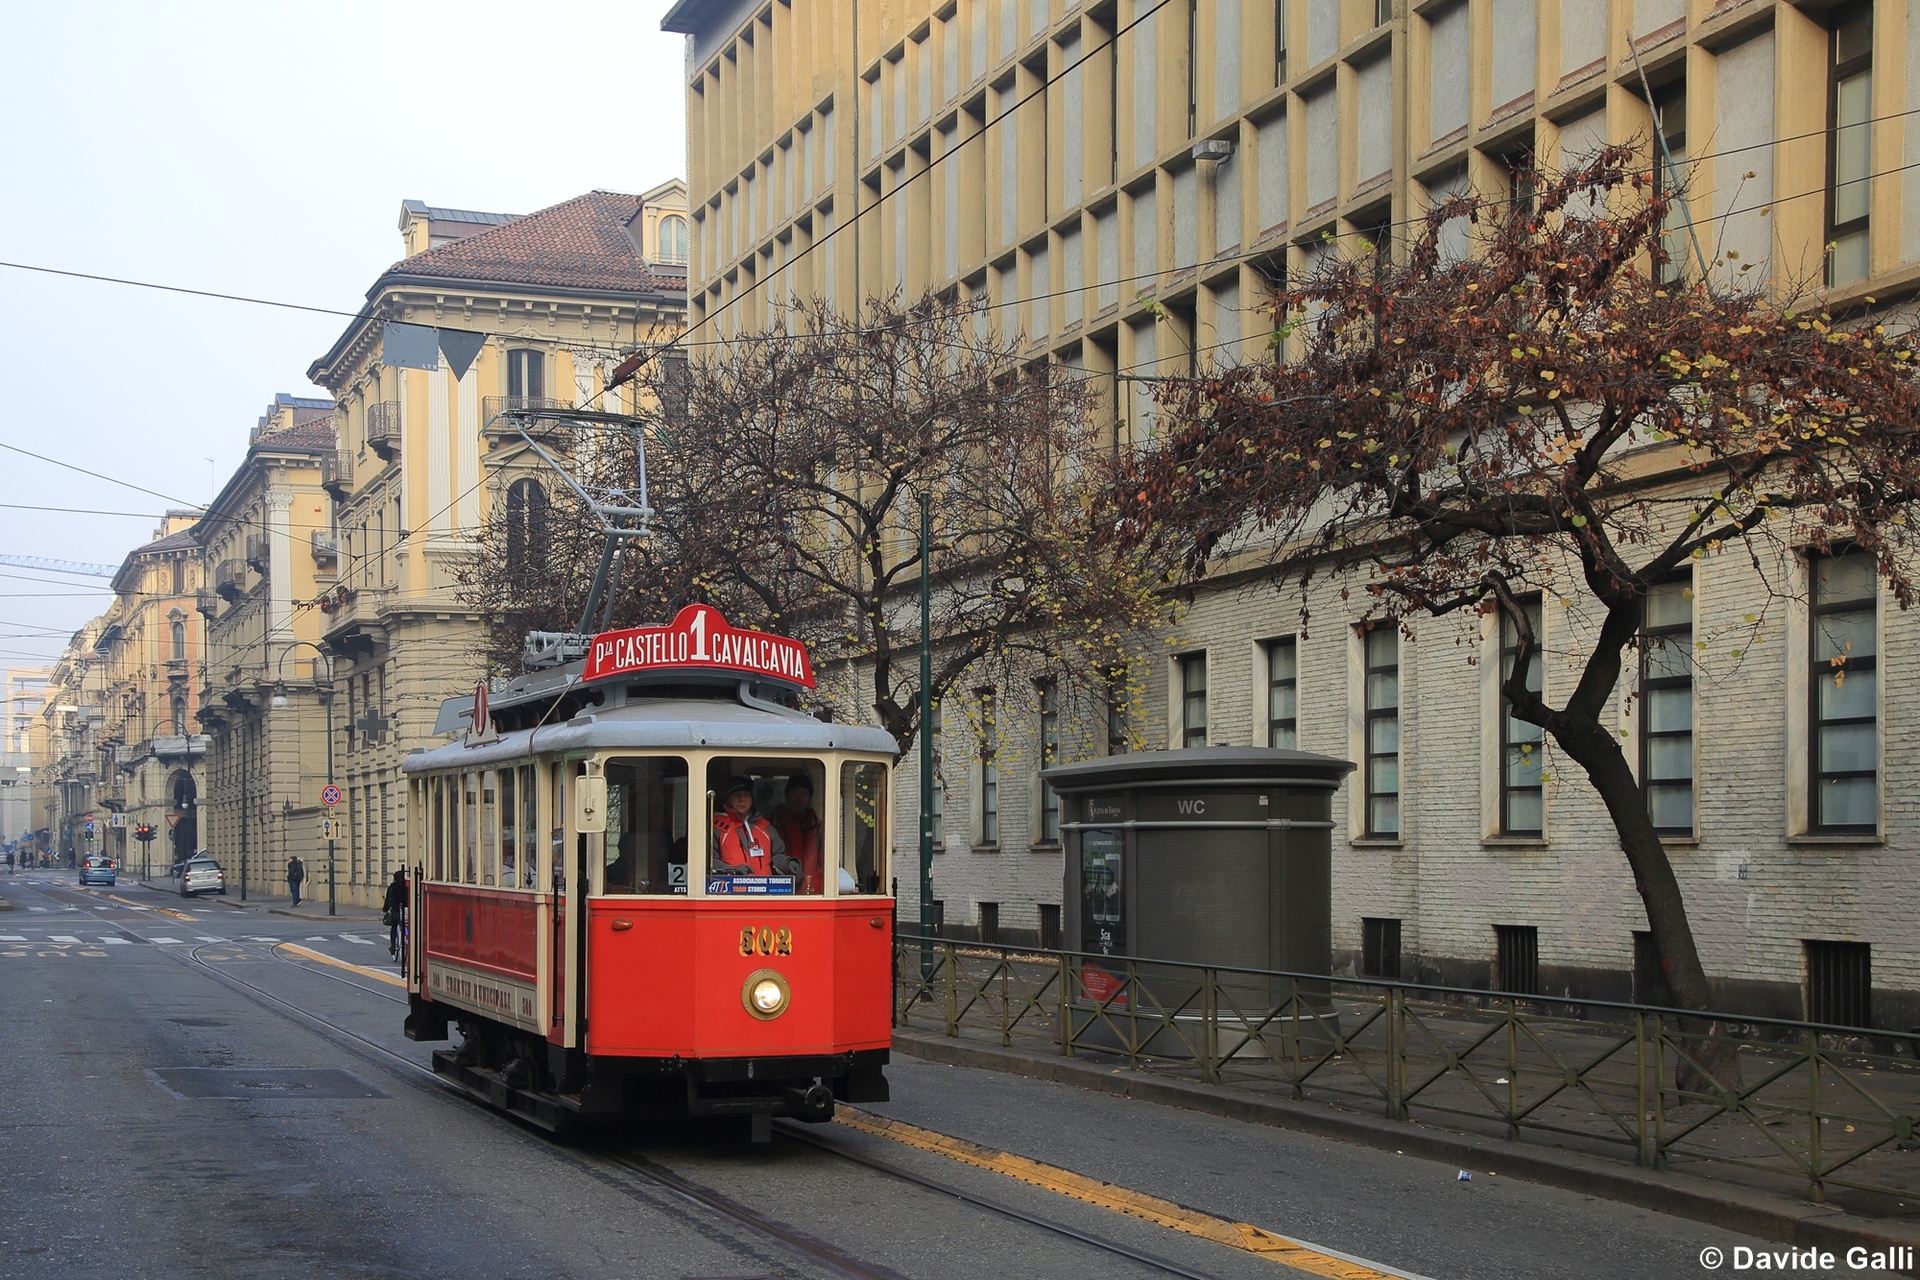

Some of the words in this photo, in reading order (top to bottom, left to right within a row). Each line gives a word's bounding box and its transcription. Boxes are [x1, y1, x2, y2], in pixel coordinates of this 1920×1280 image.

[615, 631, 687, 669] CASTELLO
[690, 610, 710, 661] 1
[712, 633, 804, 680] CAVALCAVIA
[1178, 800, 1205, 814] WC
[672, 866, 685, 883] 2
[739, 926, 793, 957] 502
